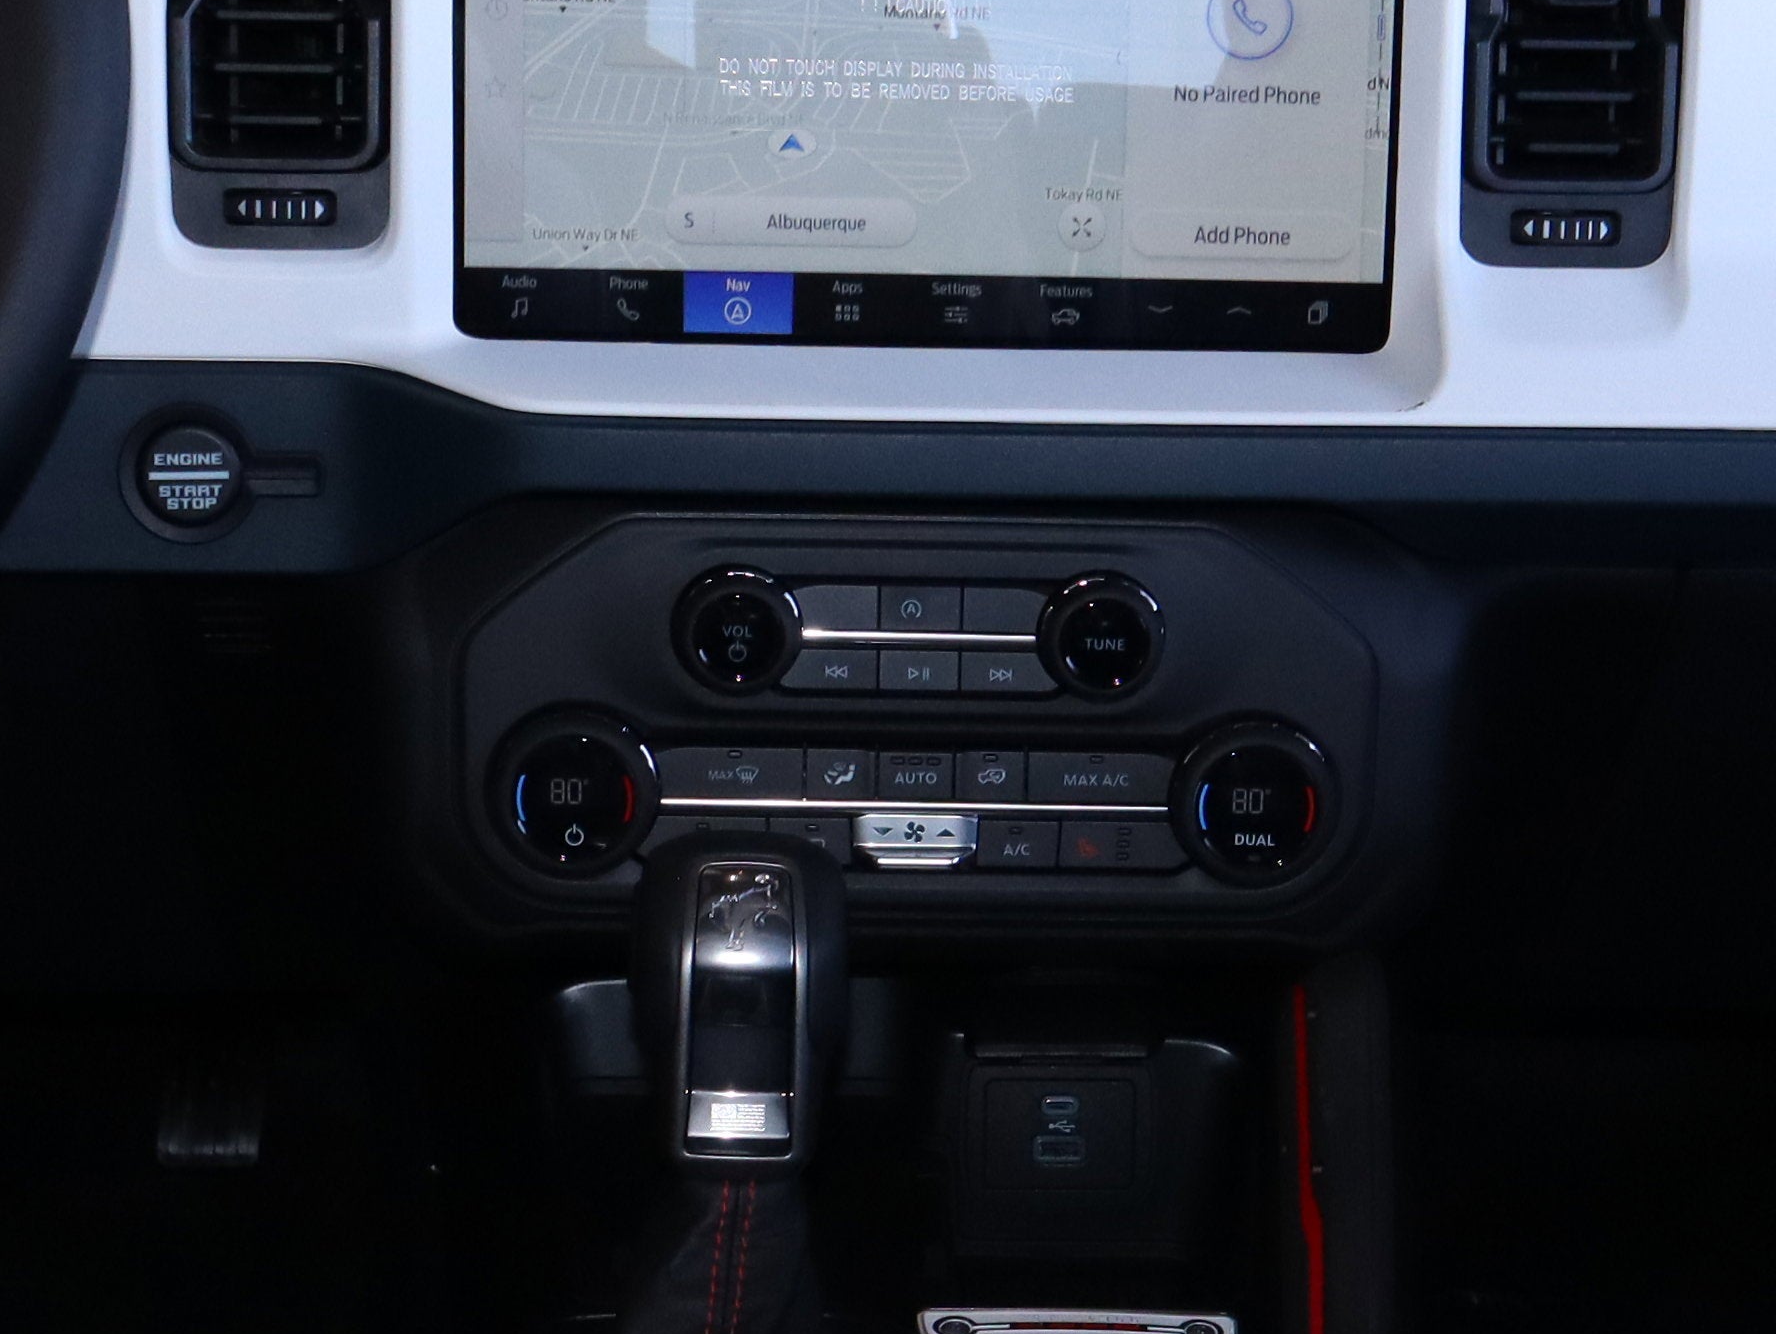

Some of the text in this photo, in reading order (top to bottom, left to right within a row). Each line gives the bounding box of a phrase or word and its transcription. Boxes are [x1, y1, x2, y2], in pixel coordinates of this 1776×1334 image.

[720, 58, 1072, 81] DO NOT TOUCH DISPLAY DURING INSTALLATION
[720, 80, 1074, 103] THIS FILM IS TO BE REMOVED BEFORE USAGE
[1174, 85, 1321, 105] No Paired Phone
[1045, 187, 1083, 203] Tokay
[1086, 188, 1102, 201] Rd
[684, 212, 694, 229] S
[766, 213, 866, 233] Albuquerque
[532, 229, 640, 243] Union Way Dr NE
[1194, 226, 1291, 246] Add Phone
[502, 275, 538, 288] Audio
[609, 276, 649, 289] Phone
[726, 279, 751, 292] Nav
[832, 280, 863, 295] Apps
[932, 282, 983, 297] Settings
[1040, 284, 1093, 298] Features
[154, 453, 223, 466] ENGINE
[159, 484, 222, 498] START
[167, 497, 217, 510] STOP
[722, 625, 752, 639] VOL
[1084, 637, 1126, 651] TUNE
[708, 769, 734, 781] MAX
[894, 771, 937, 785] AUTO
[1064, 773, 1129, 788] MAX A/C
[1234, 833, 1275, 847] DUAL
[1004, 843, 1030, 857] A/C
